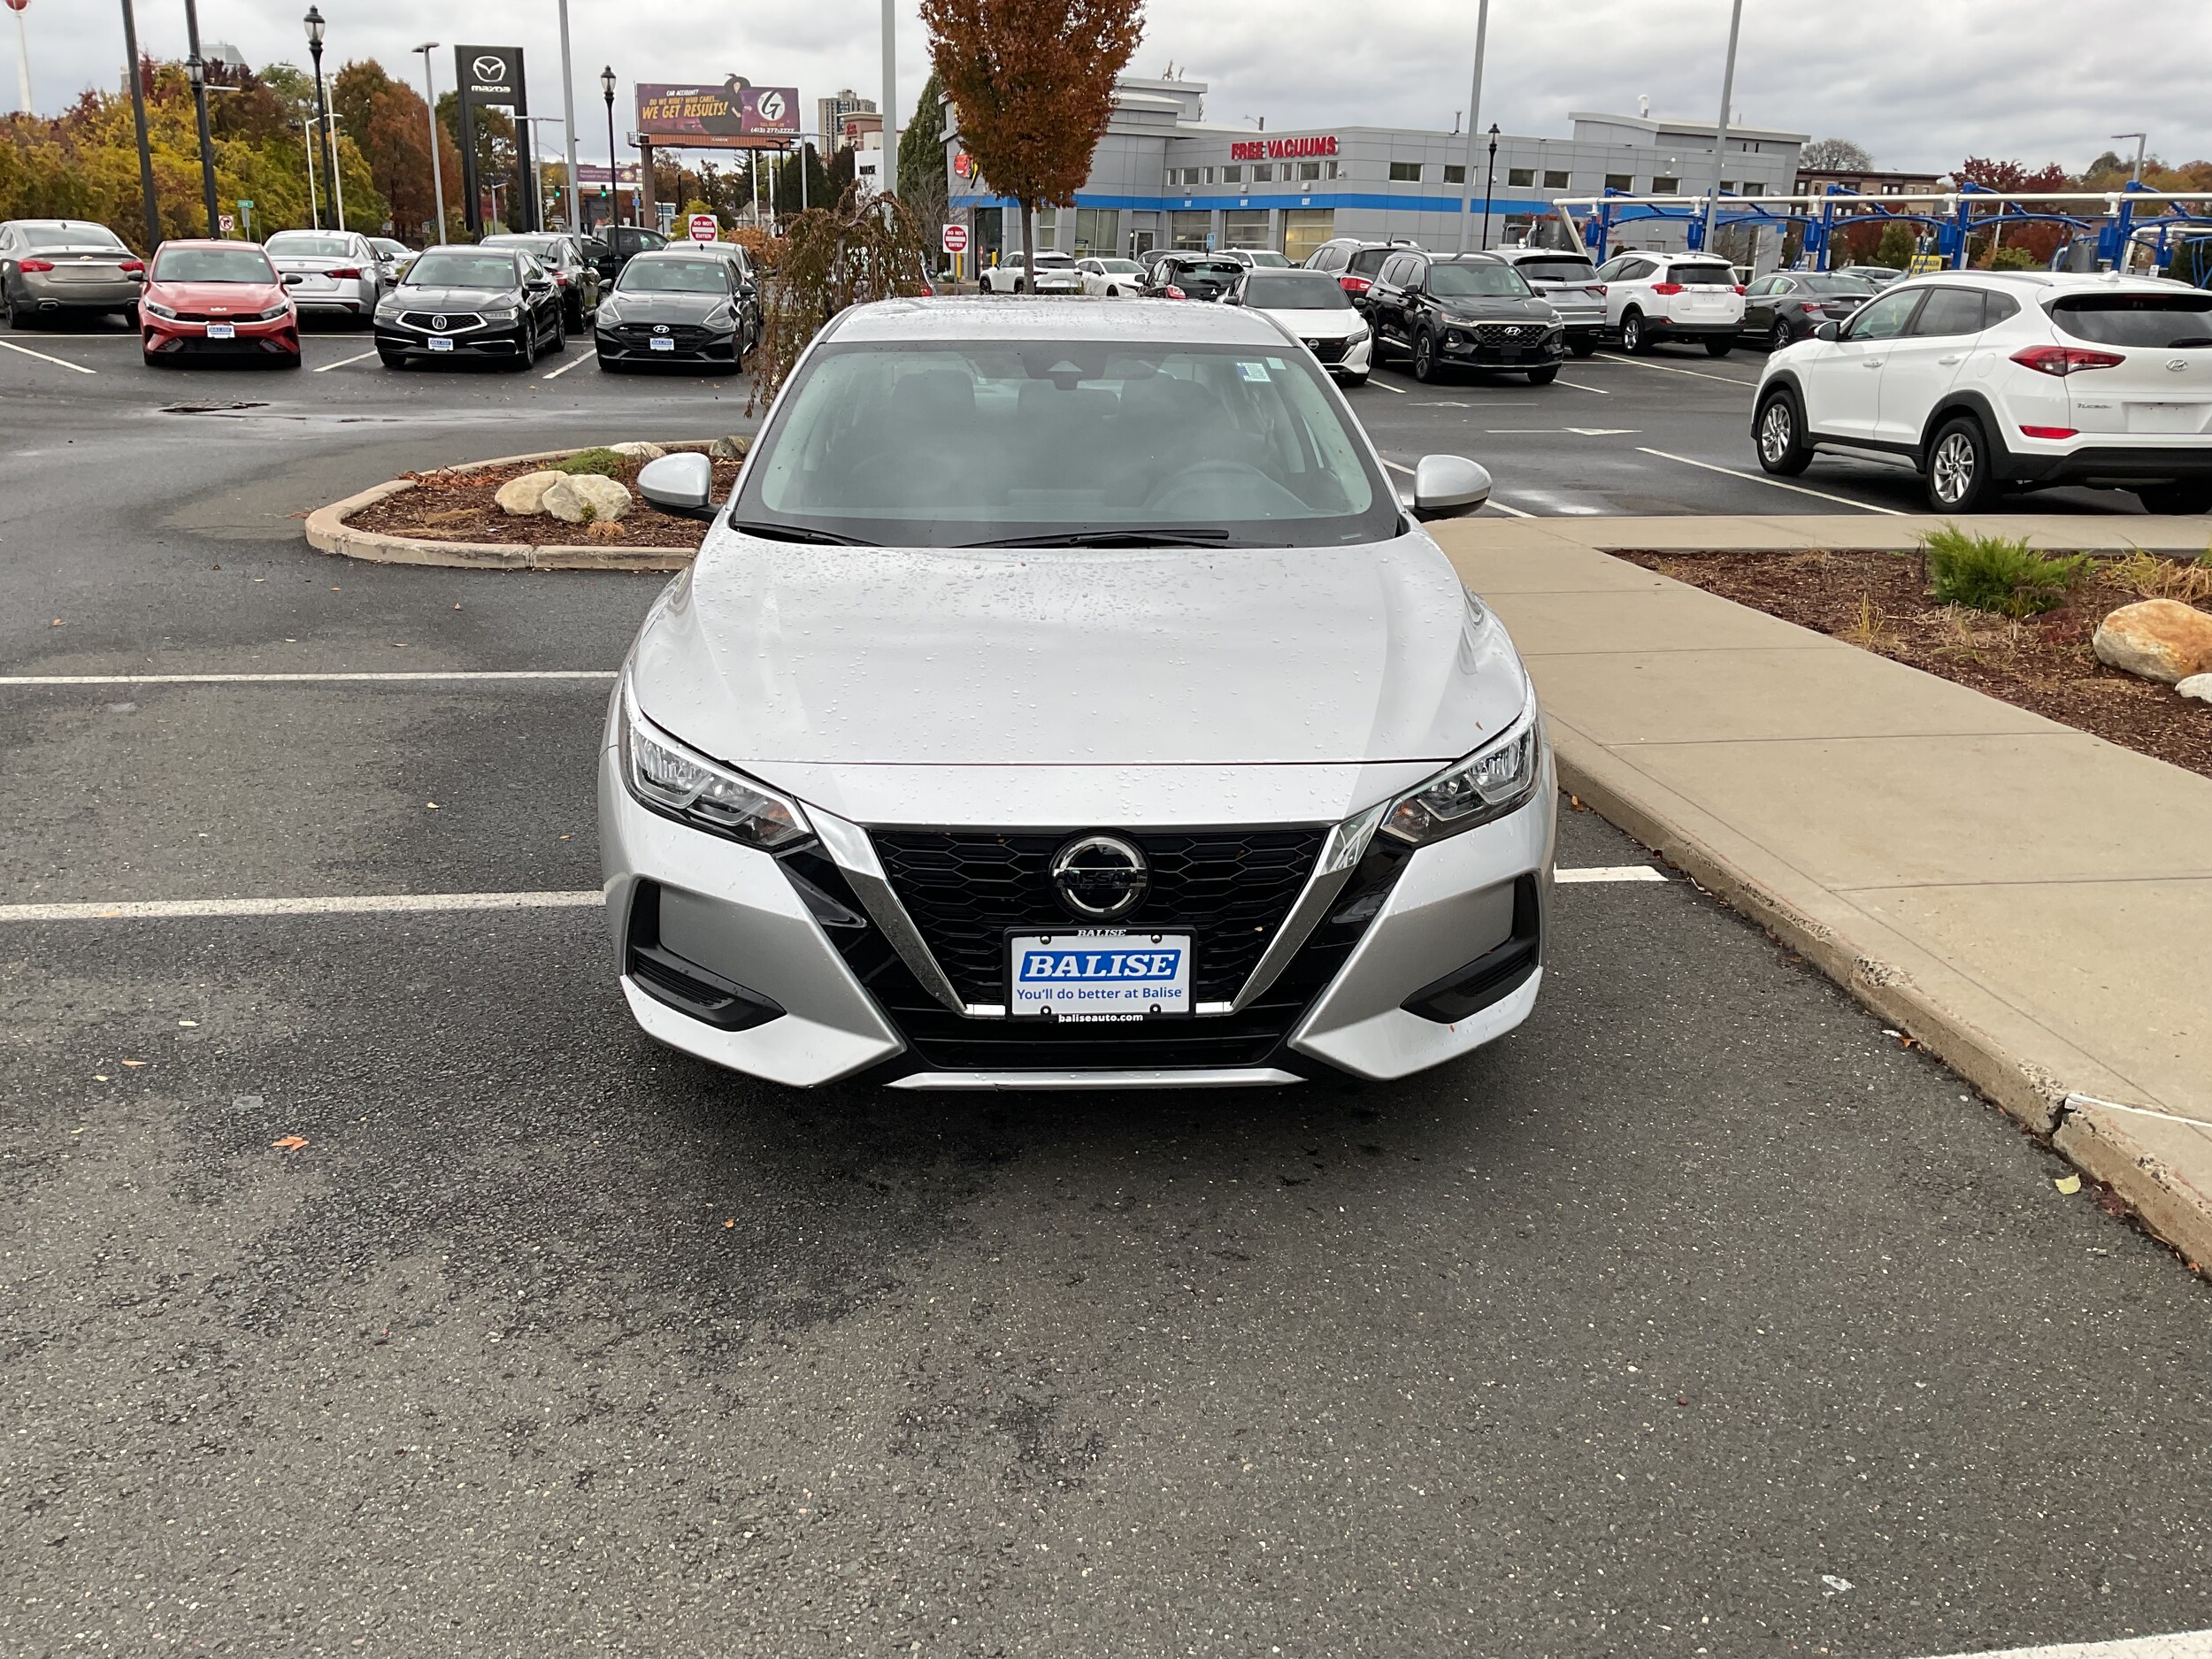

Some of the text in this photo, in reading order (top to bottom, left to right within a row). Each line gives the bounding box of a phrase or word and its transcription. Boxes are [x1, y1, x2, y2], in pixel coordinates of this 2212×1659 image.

[642, 102, 728, 119] WE GET RESULTS!
[1231, 136, 1337, 159] FREE VACUUMS
[1025, 954, 1175, 978] BALISE
[1017, 987, 1182, 1000] You'll do better at Balise
[1058, 1014, 1143, 1023] baliseauto.com
